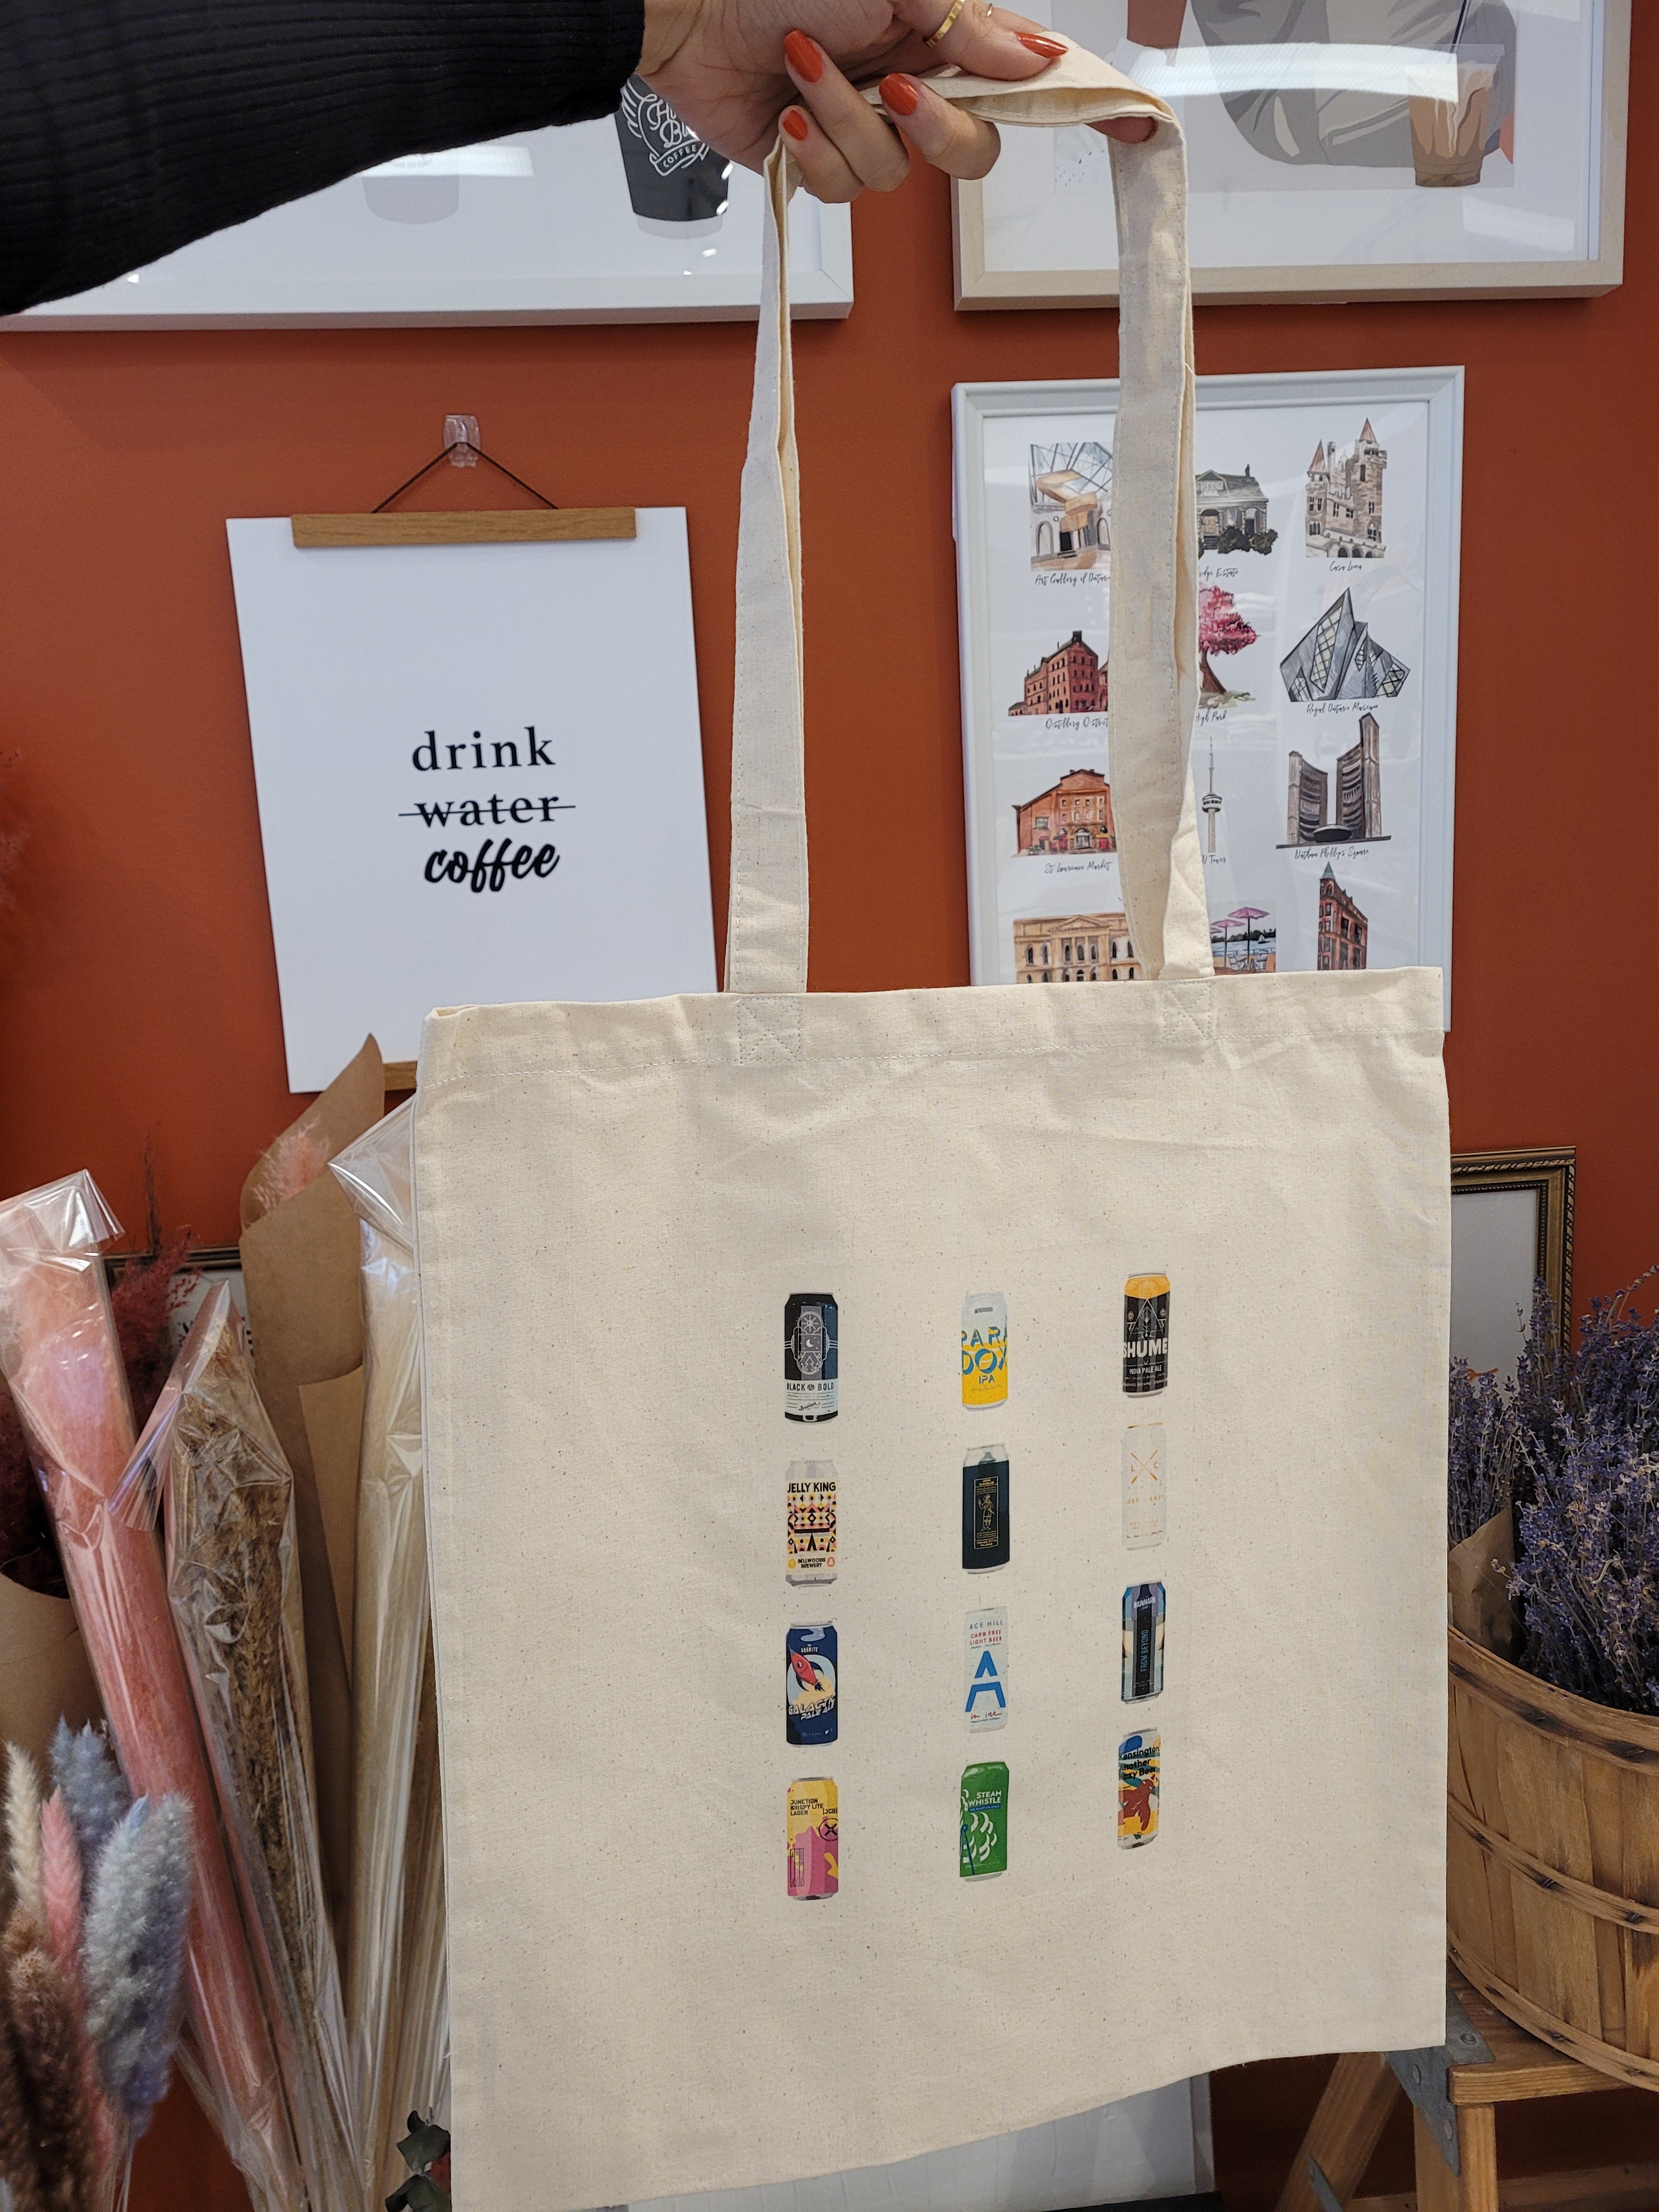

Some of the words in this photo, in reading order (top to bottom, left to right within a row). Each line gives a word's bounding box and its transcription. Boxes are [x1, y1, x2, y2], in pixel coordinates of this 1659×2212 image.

[663, 144, 698, 167] COFFEE
[1216, 567, 1238, 577] Estate
[1050, 572, 1077, 586] Gallery
[1306, 703, 1326, 717] Royal
[1328, 703, 1350, 714] Ontario
[413, 726, 556, 771] drink
[413, 793, 560, 828] water
[1209, 854, 1226, 864] Tower
[425, 837, 560, 893] coffee
[1142, 1365, 1154, 1374] PALE
[979, 1374, 995, 1385] IPA
[786, 1382, 805, 1391] BLACK
[817, 1382, 834, 1391] BOLD
[787, 1482, 811, 1493] JELLY
[813, 1482, 836, 1492] KING
[970, 1638, 986, 1646] LIGHT
[801, 1708, 822, 1721] PALE
[822, 1701, 834, 1714] ALE
[976, 1790, 1002, 1799] STEAM
[968, 1796, 1001, 1807] WHISTLE
